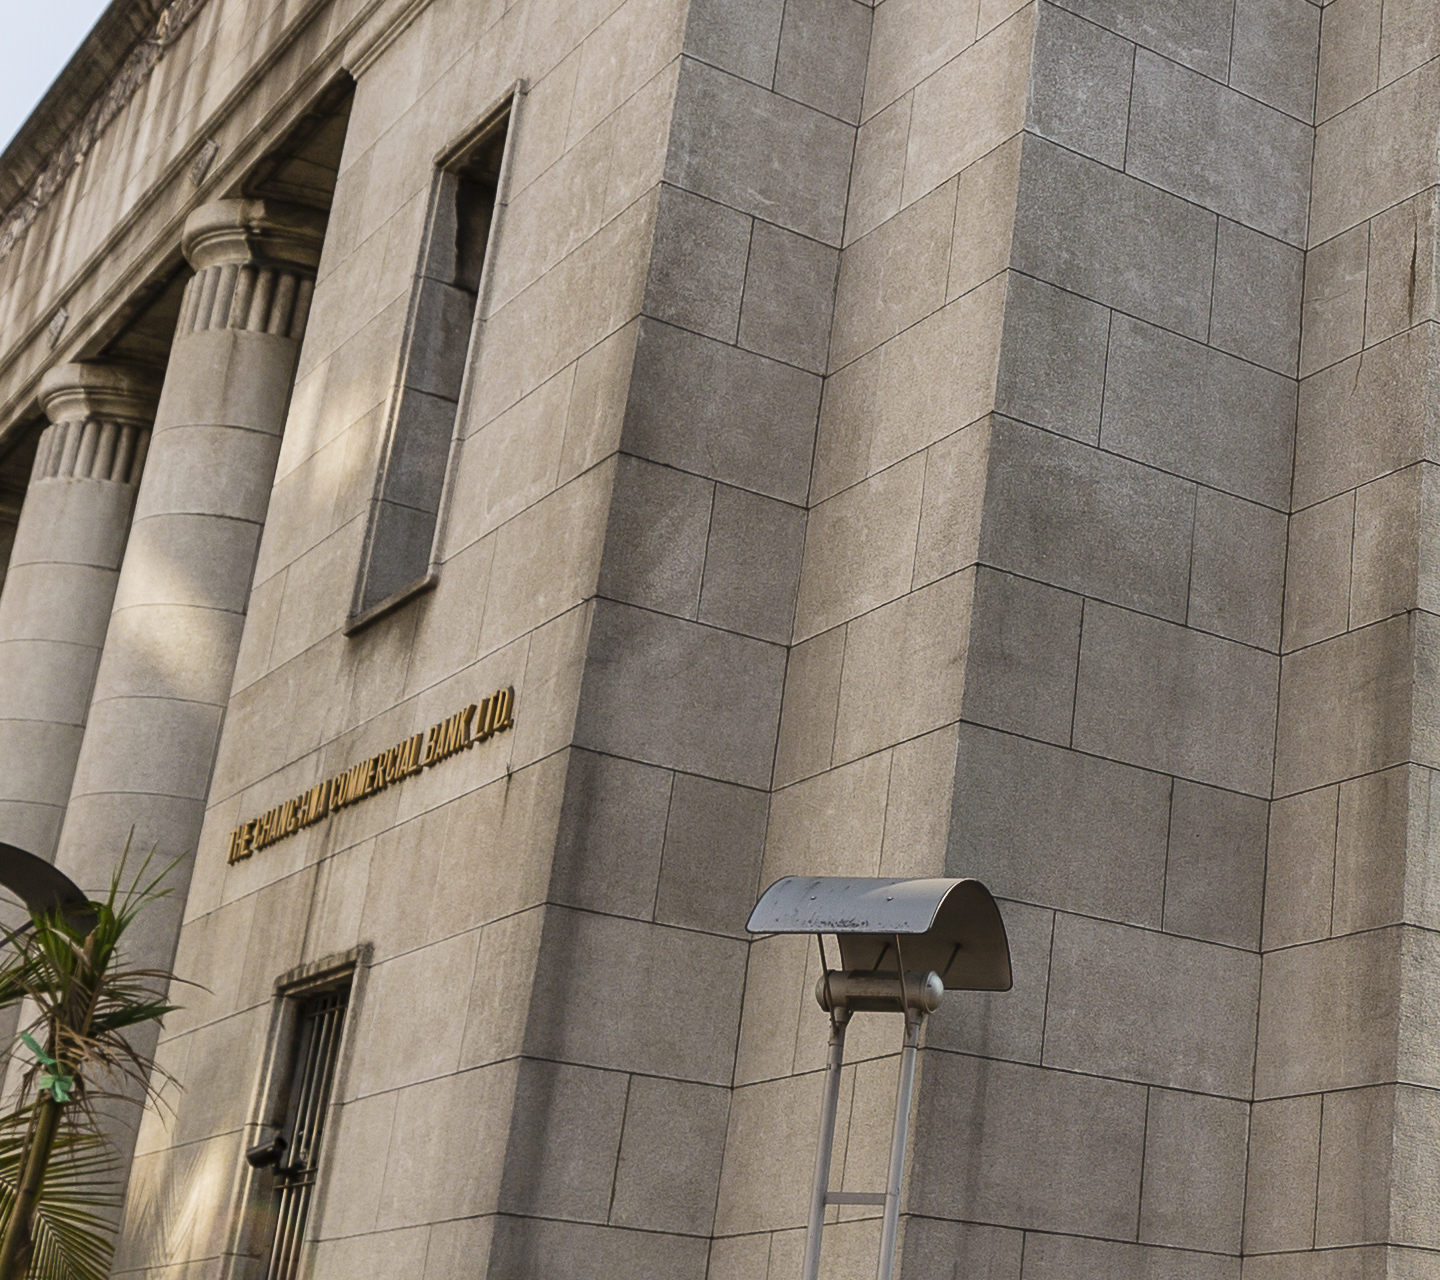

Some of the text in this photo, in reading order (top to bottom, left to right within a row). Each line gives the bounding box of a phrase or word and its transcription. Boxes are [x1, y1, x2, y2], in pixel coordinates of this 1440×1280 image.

[227, 821, 255, 865] THE
[251, 797, 299, 852] CHANG
[297, 778, 332, 829] HWA
[328, 732, 425, 812] COMMERCIAL
[474, 686, 515, 742] LTD.
